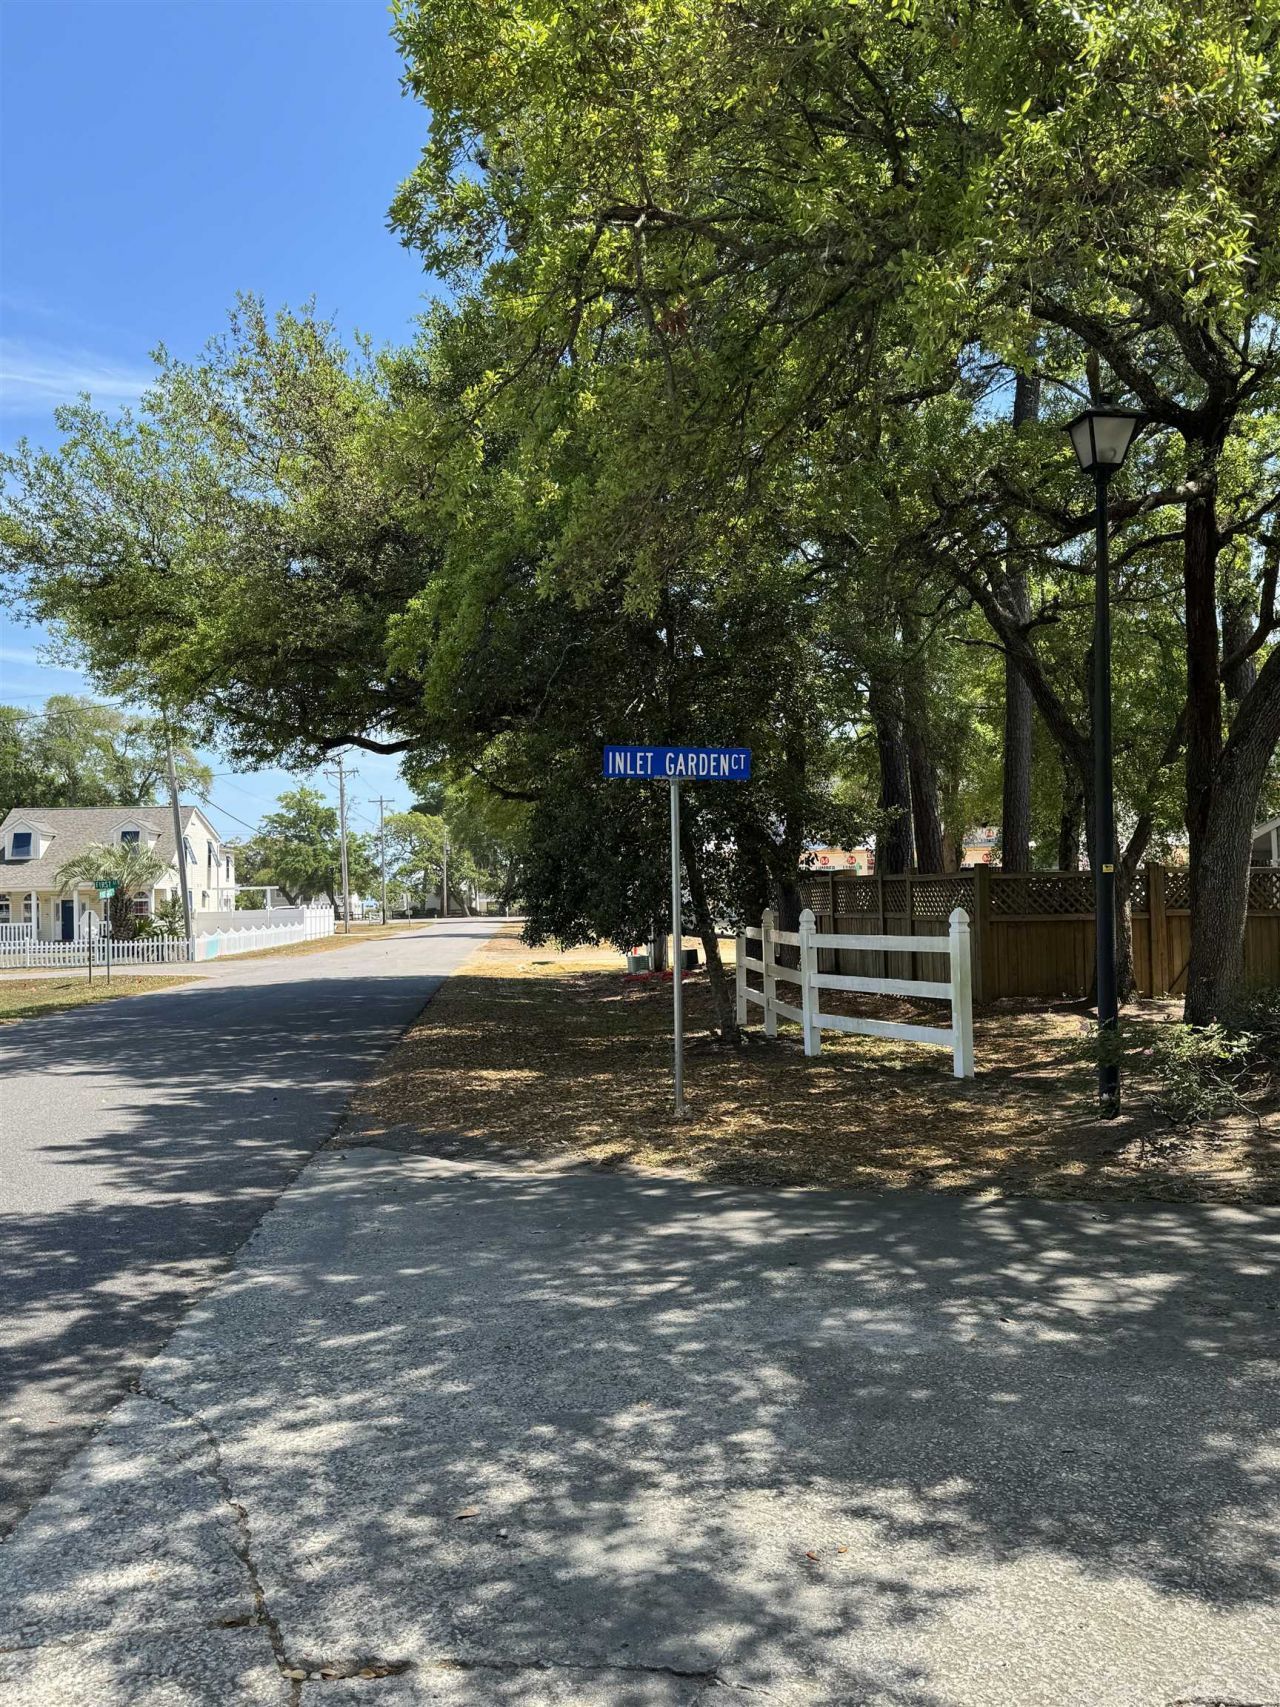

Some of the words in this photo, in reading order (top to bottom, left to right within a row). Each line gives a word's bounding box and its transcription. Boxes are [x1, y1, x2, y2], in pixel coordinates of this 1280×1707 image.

[608, 752, 653, 775] INLET
[665, 752, 729, 776] GARDEN
[731, 754, 746, 770] CT
